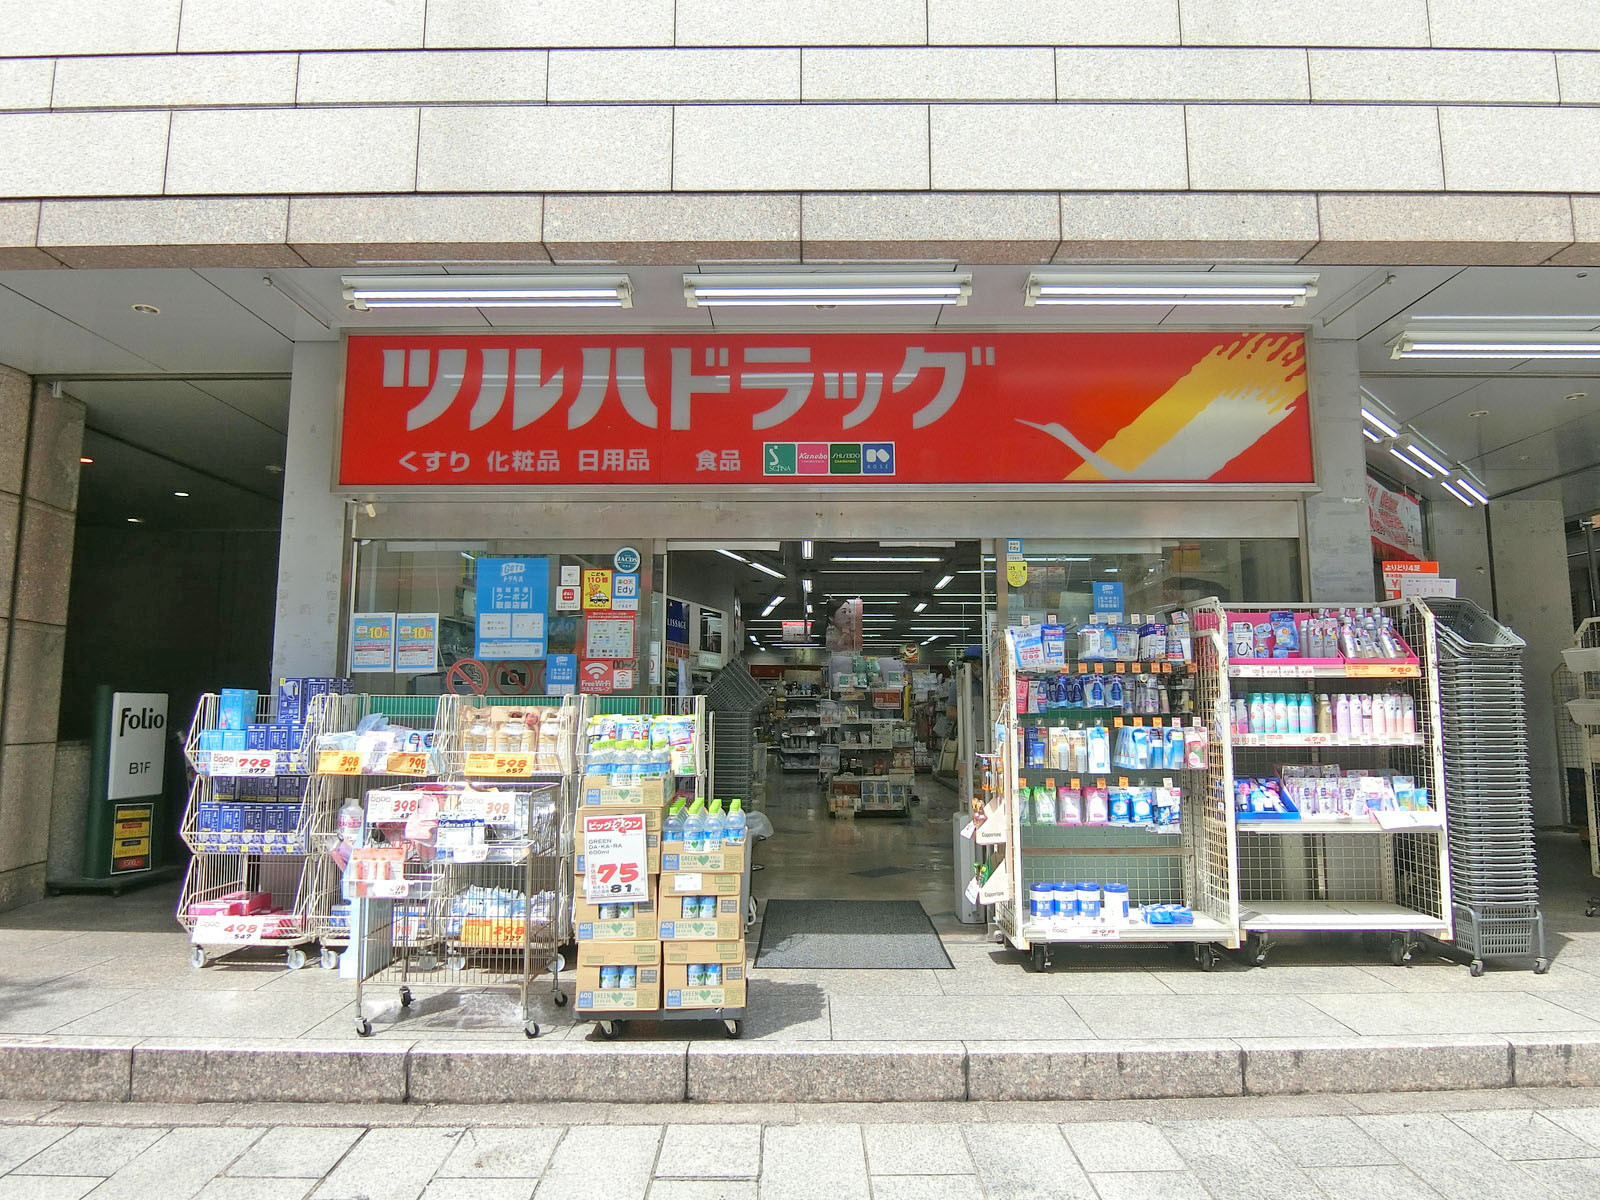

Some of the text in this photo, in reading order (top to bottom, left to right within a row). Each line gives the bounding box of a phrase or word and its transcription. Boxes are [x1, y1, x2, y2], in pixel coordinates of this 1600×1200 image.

[383, 346, 995, 431] ツルハドラッグ
[398, 449, 741, 473] くすり 化粧品 日用品 食品
[799, 452, 828, 460] Kanebo
[617, 586, 634, 595] Edy
[119, 707, 165, 737] folio
[238, 758, 271, 768] 798
[340, 756, 360, 767] 398
[409, 757, 426, 769] 798
[496, 760, 528, 768] 598
[129, 761, 152, 775] B1F
[392, 800, 418, 812] 398
[486, 802, 510, 814] 398
[597, 863, 639, 883] 75
[610, 883, 632, 893] 81
[223, 923, 258, 933] 498
[493, 926, 527, 935] 298
